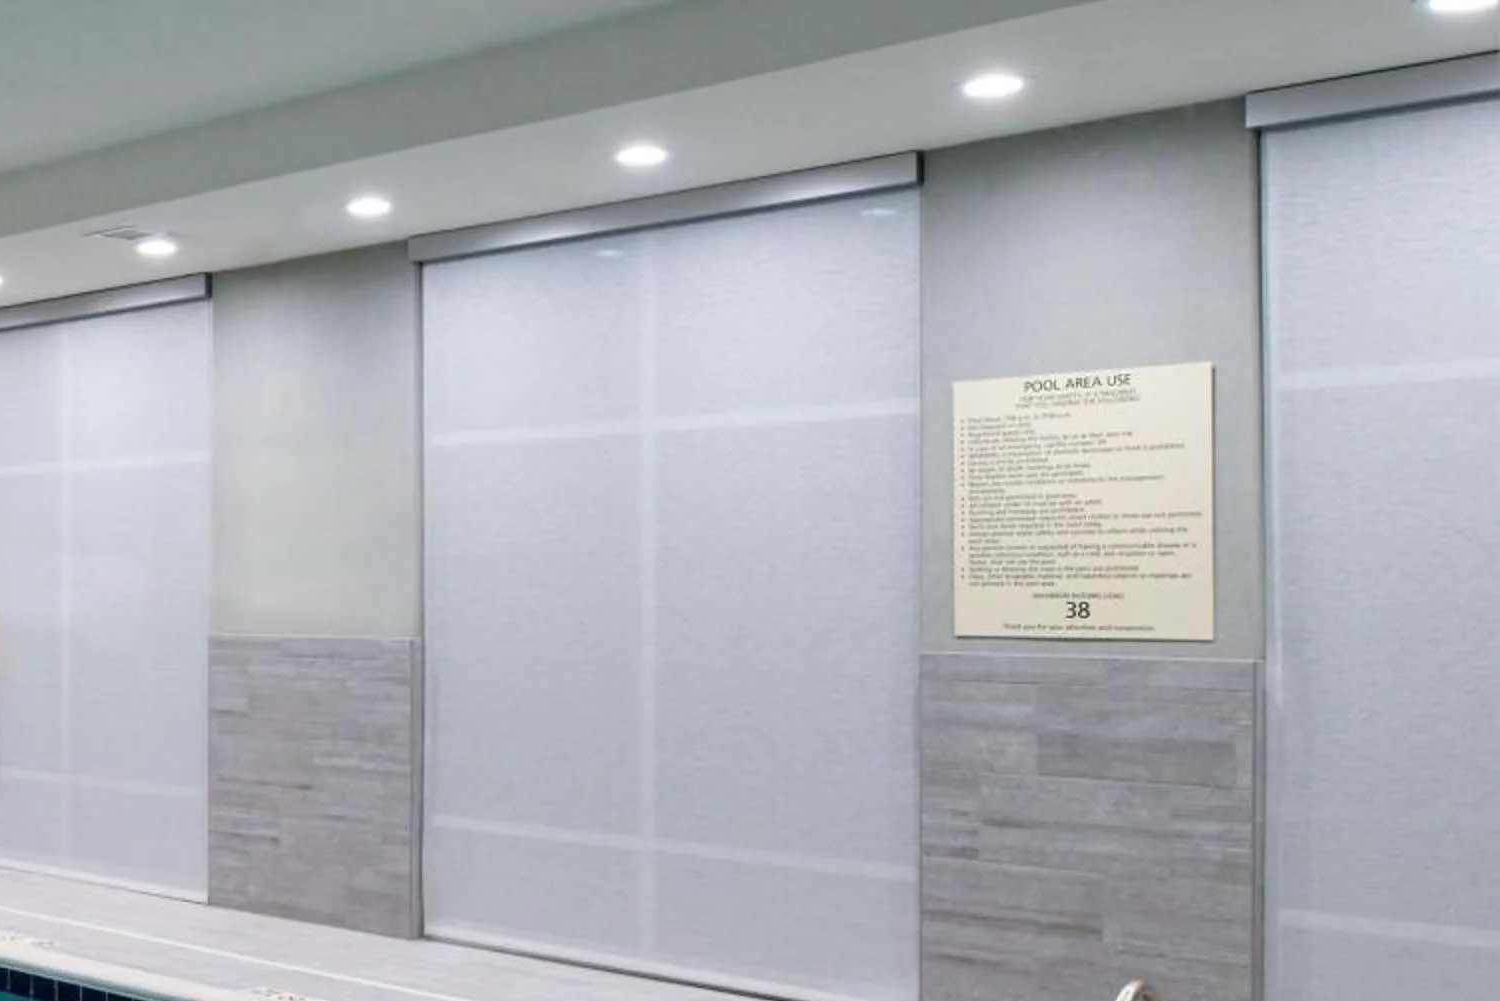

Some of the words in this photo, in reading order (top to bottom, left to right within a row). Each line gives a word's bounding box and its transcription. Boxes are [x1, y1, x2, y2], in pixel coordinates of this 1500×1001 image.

[1023, 378, 1060, 394] POOL
[1065, 374, 1102, 390] AREA
[1107, 373, 1132, 387] USE
[1064, 601, 1091, 619] 38
